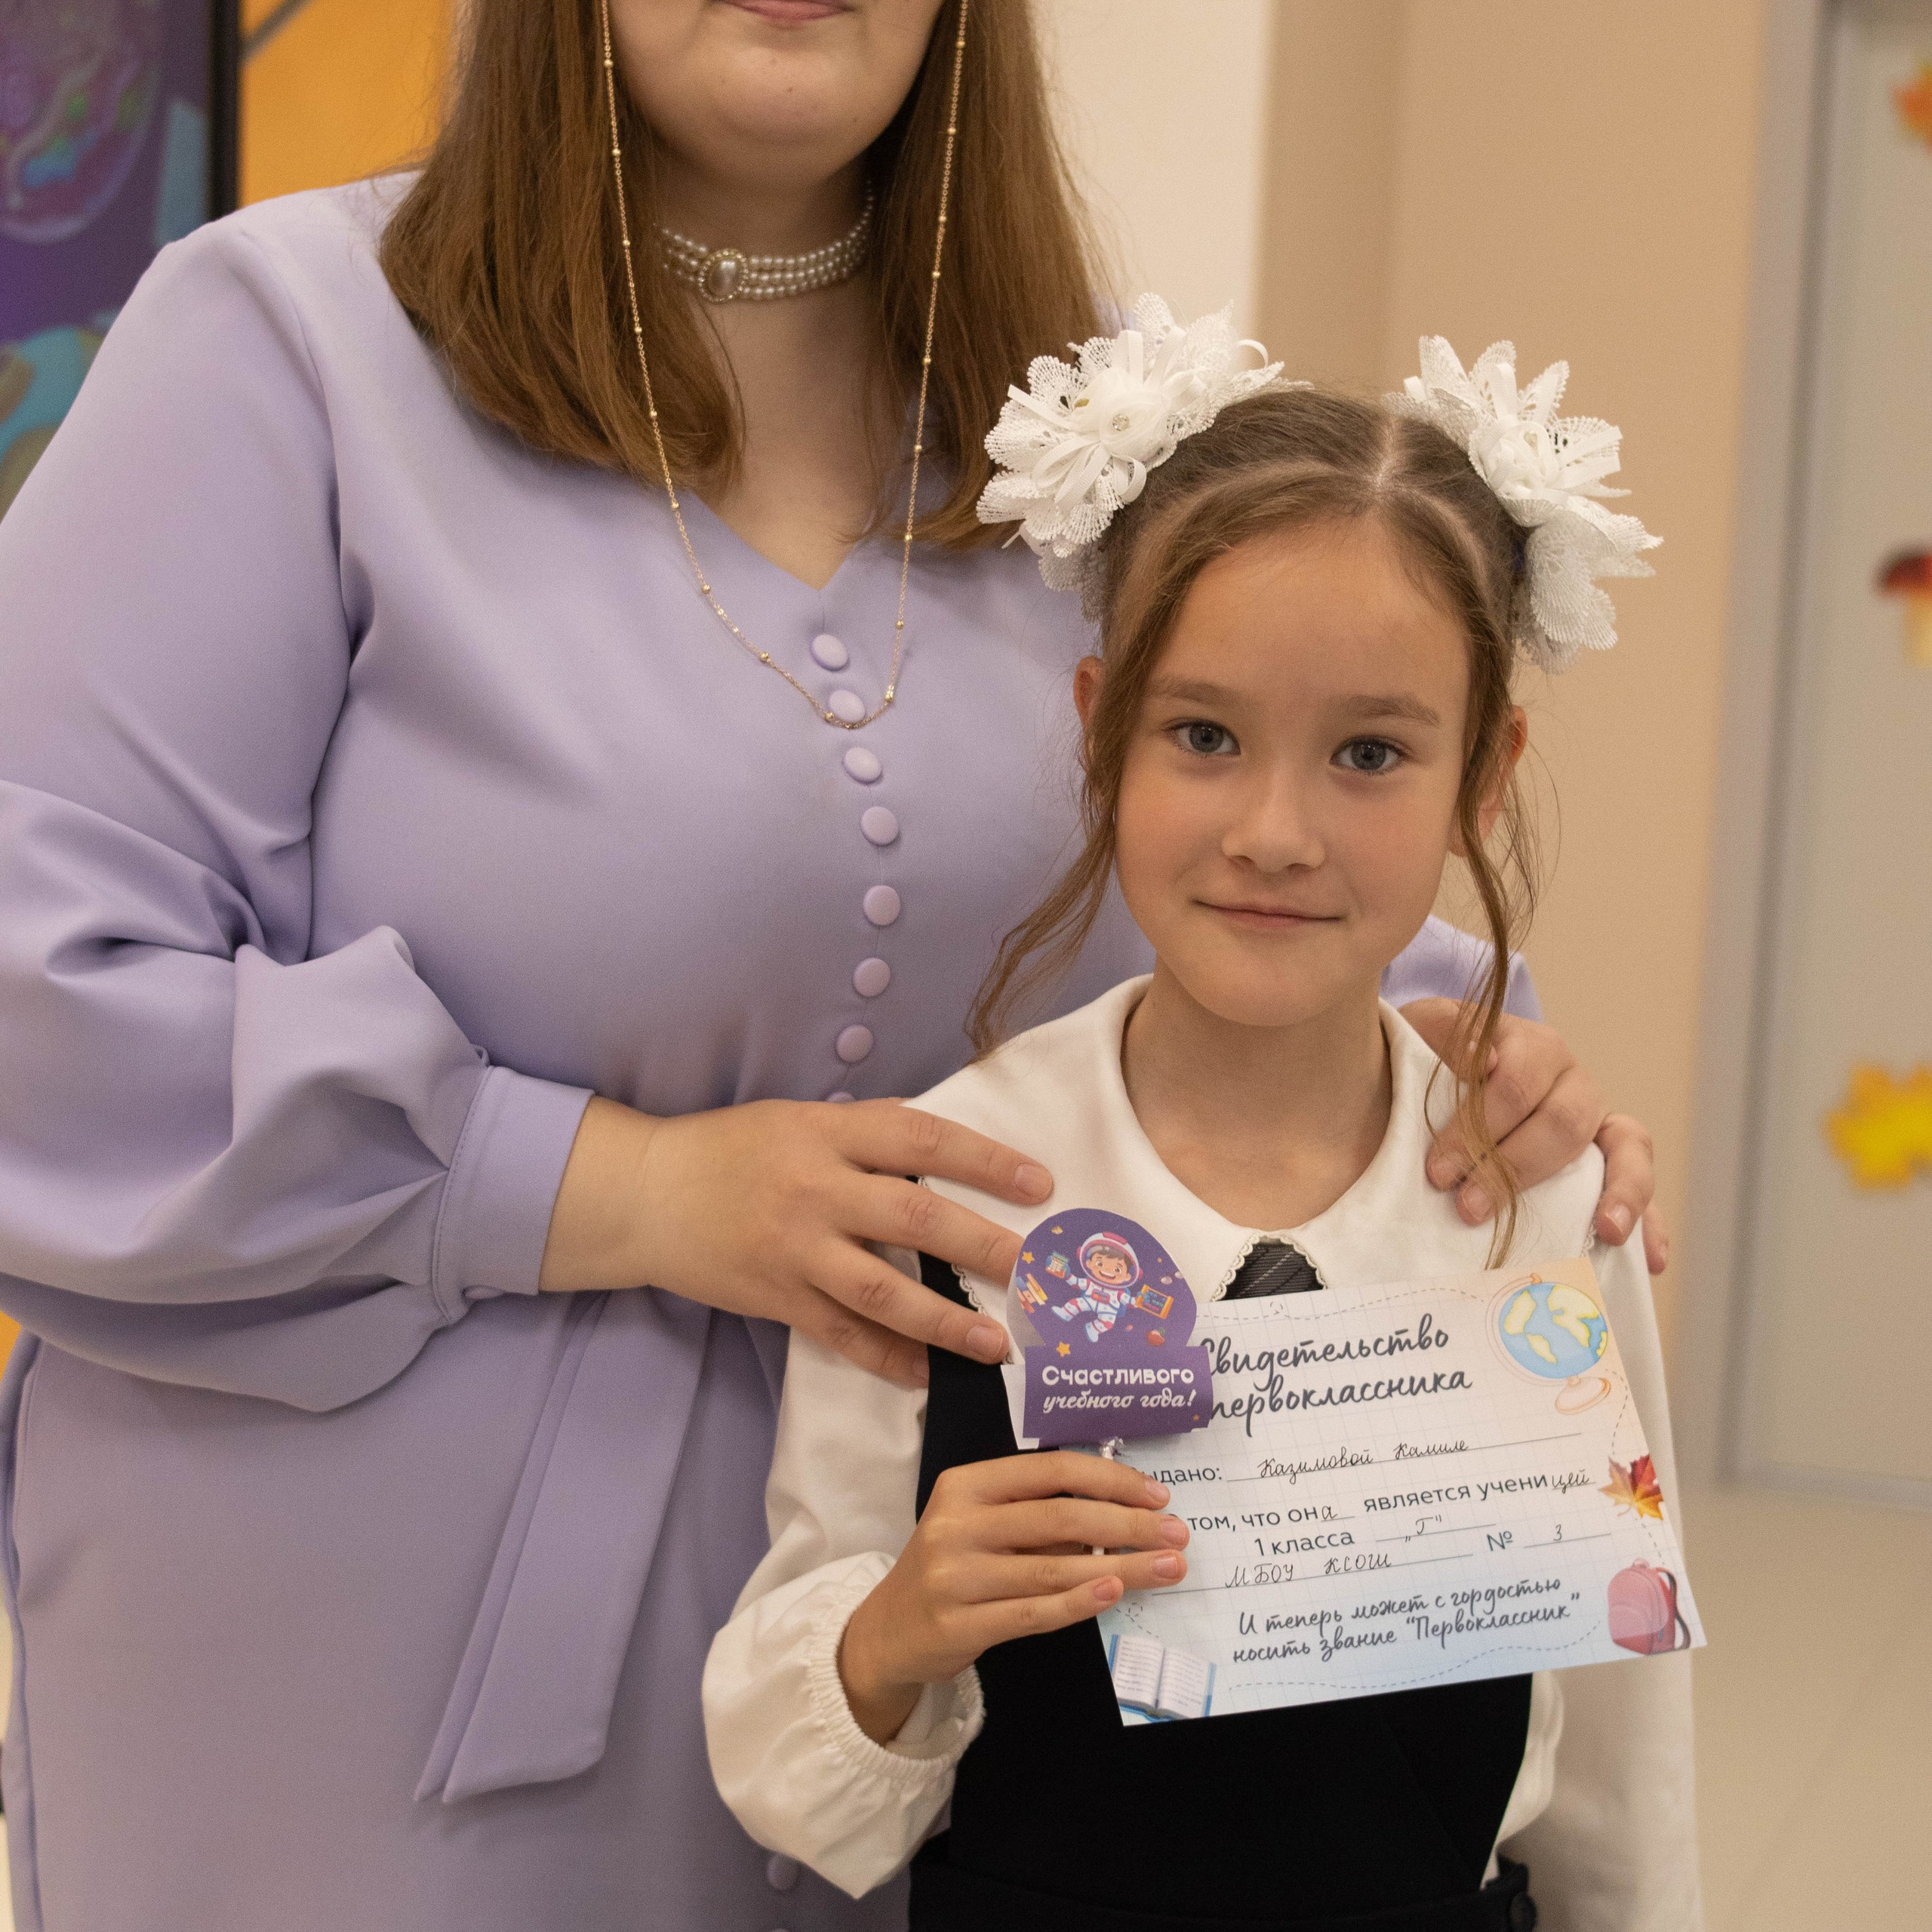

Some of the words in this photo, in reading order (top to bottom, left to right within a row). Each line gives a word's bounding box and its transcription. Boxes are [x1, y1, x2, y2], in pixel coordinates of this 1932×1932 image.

[1041, 1365, 1194, 1386] Счастливого
[1043, 1389, 1134, 1413] учебного
[1140, 1388, 1197, 1407] года!
[1187, 1515, 1236, 1532] том,
[1242, 1512, 1281, 1527] что
[1364, 1484, 1472, 1512] является
[1225, 1564, 1294, 1588] МБОУ
[1486, 1531, 1514, 1552] №
[1552, 1524, 1563, 1542] 3
[1254, 1537, 1265, 1556] 1
[1271, 1531, 1355, 1555] класса
[1239, 1610, 1257, 1635] И
[1265, 1611, 1343, 1638] теперь
[1351, 1593, 1429, 1620] может
[1435, 1595, 1445, 1609] с
[1451, 1577, 1561, 1616] гордостью
[1232, 1641, 1312, 1663] носить
[1319, 1626, 1398, 1661] звание
